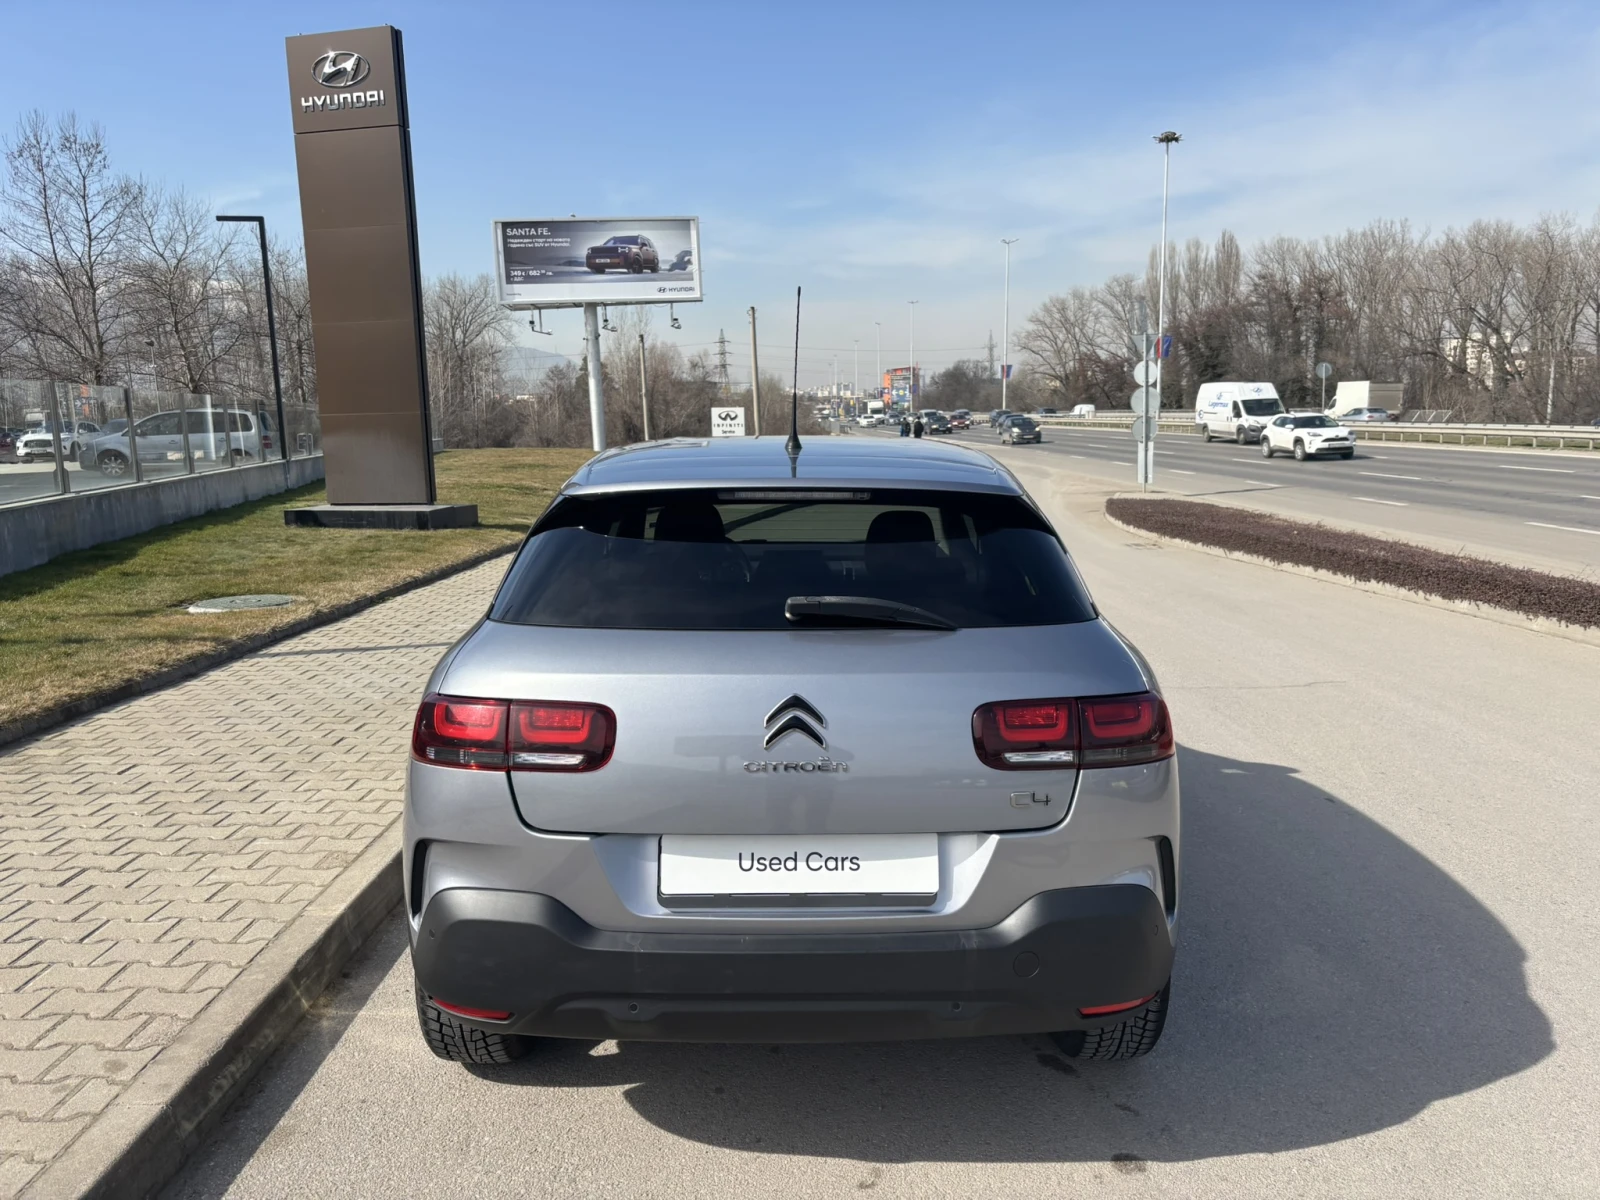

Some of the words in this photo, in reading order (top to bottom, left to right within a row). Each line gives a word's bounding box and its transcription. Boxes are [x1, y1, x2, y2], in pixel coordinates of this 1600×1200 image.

[301, 90, 385, 113] HYUNDAI
[506, 228, 537, 236] SANTA
[1010, 791, 1051, 808] C4
[738, 851, 798, 872] Used
[805, 851, 861, 872] Cars
